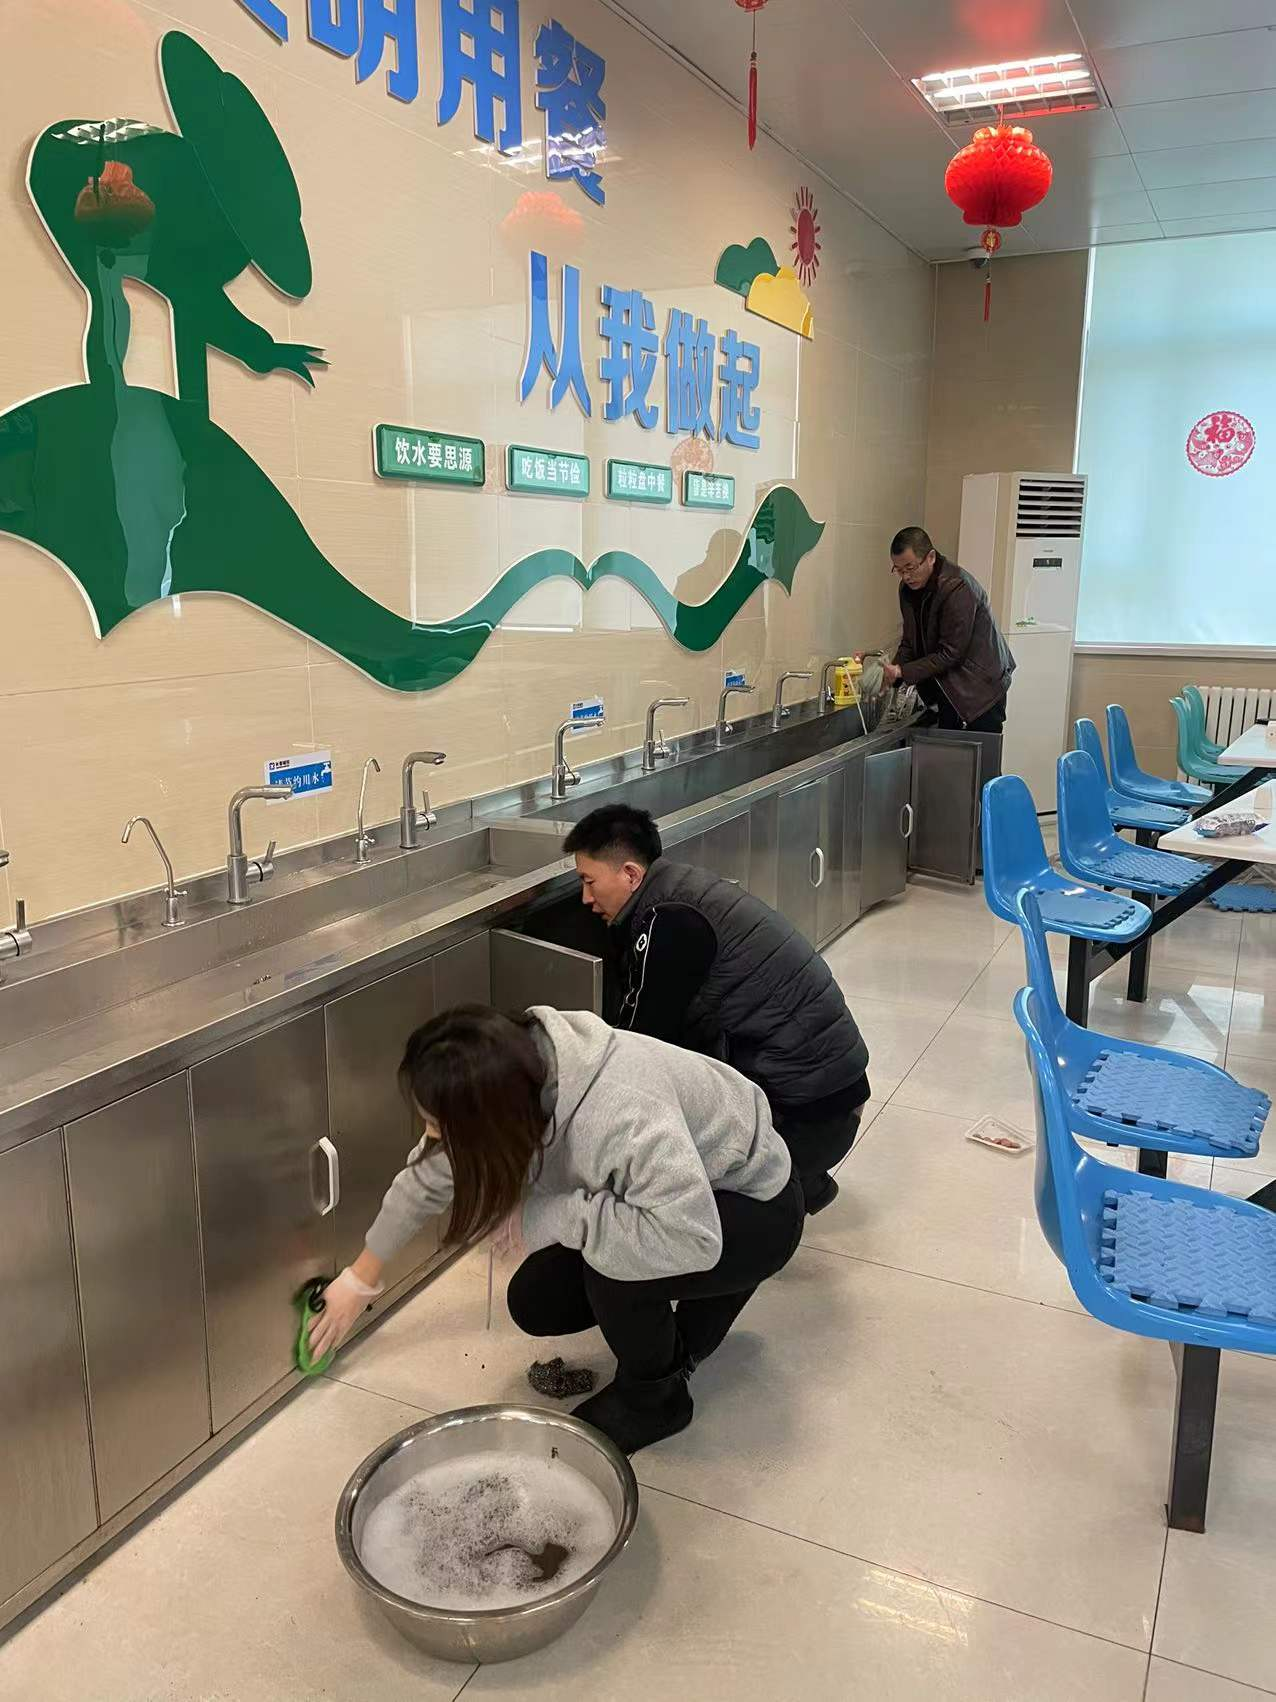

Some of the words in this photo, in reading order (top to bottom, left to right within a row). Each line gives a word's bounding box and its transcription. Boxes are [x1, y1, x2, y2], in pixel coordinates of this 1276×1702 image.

[235, 0, 607, 207] 明用餐
[520, 250, 761, 449] 从我做起
[395, 437, 473, 472] 饮水要思源
[521, 456, 581, 484] 吃饭当节俭
[617, 467, 665, 493] 粒粒盘中餐
